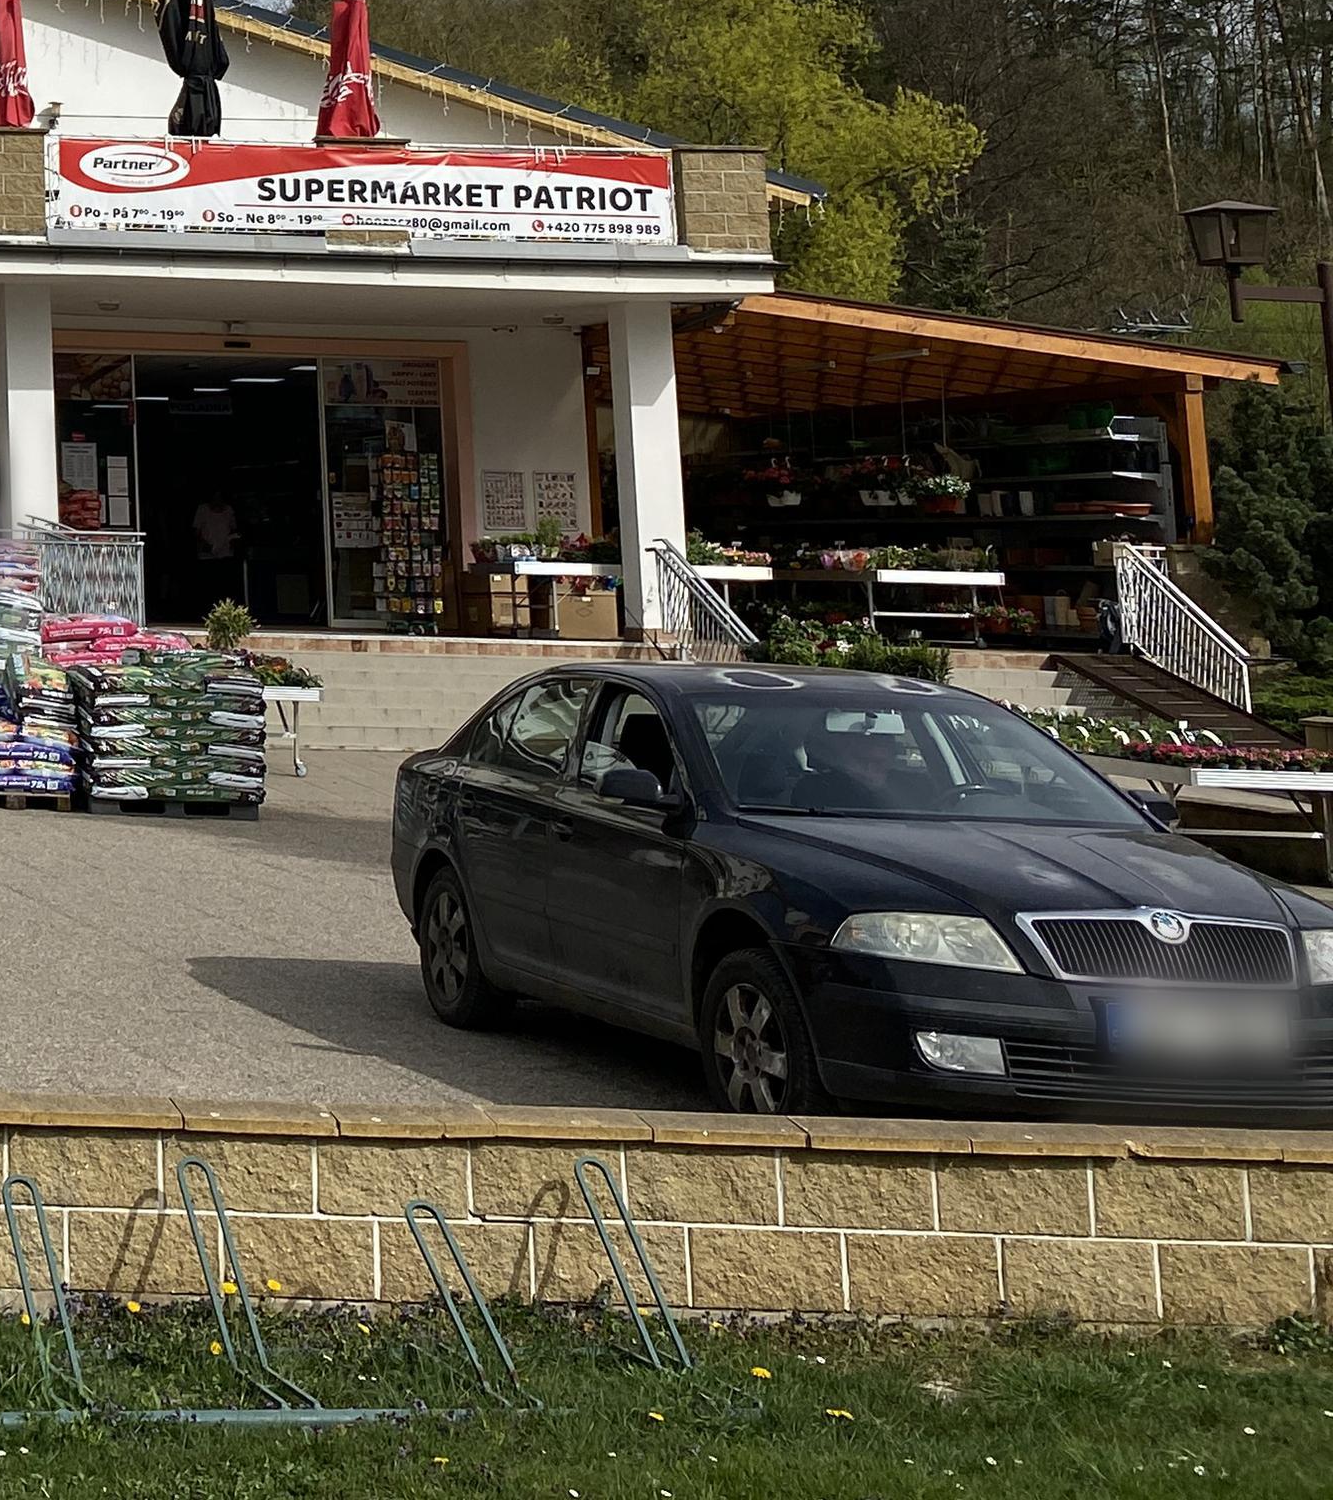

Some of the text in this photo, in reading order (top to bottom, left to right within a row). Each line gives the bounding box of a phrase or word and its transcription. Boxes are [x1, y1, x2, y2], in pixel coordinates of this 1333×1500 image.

[93, 157, 156, 171] Partner
[257, 177, 653, 212] SUPERMARKET PATRIOT
[84, 207, 101, 217] Po
[113, 206, 129, 218] Pá
[218, 212, 234, 223] So
[246, 213, 264, 224] Ne
[547, 221, 661, 235] +420 775 898 989
